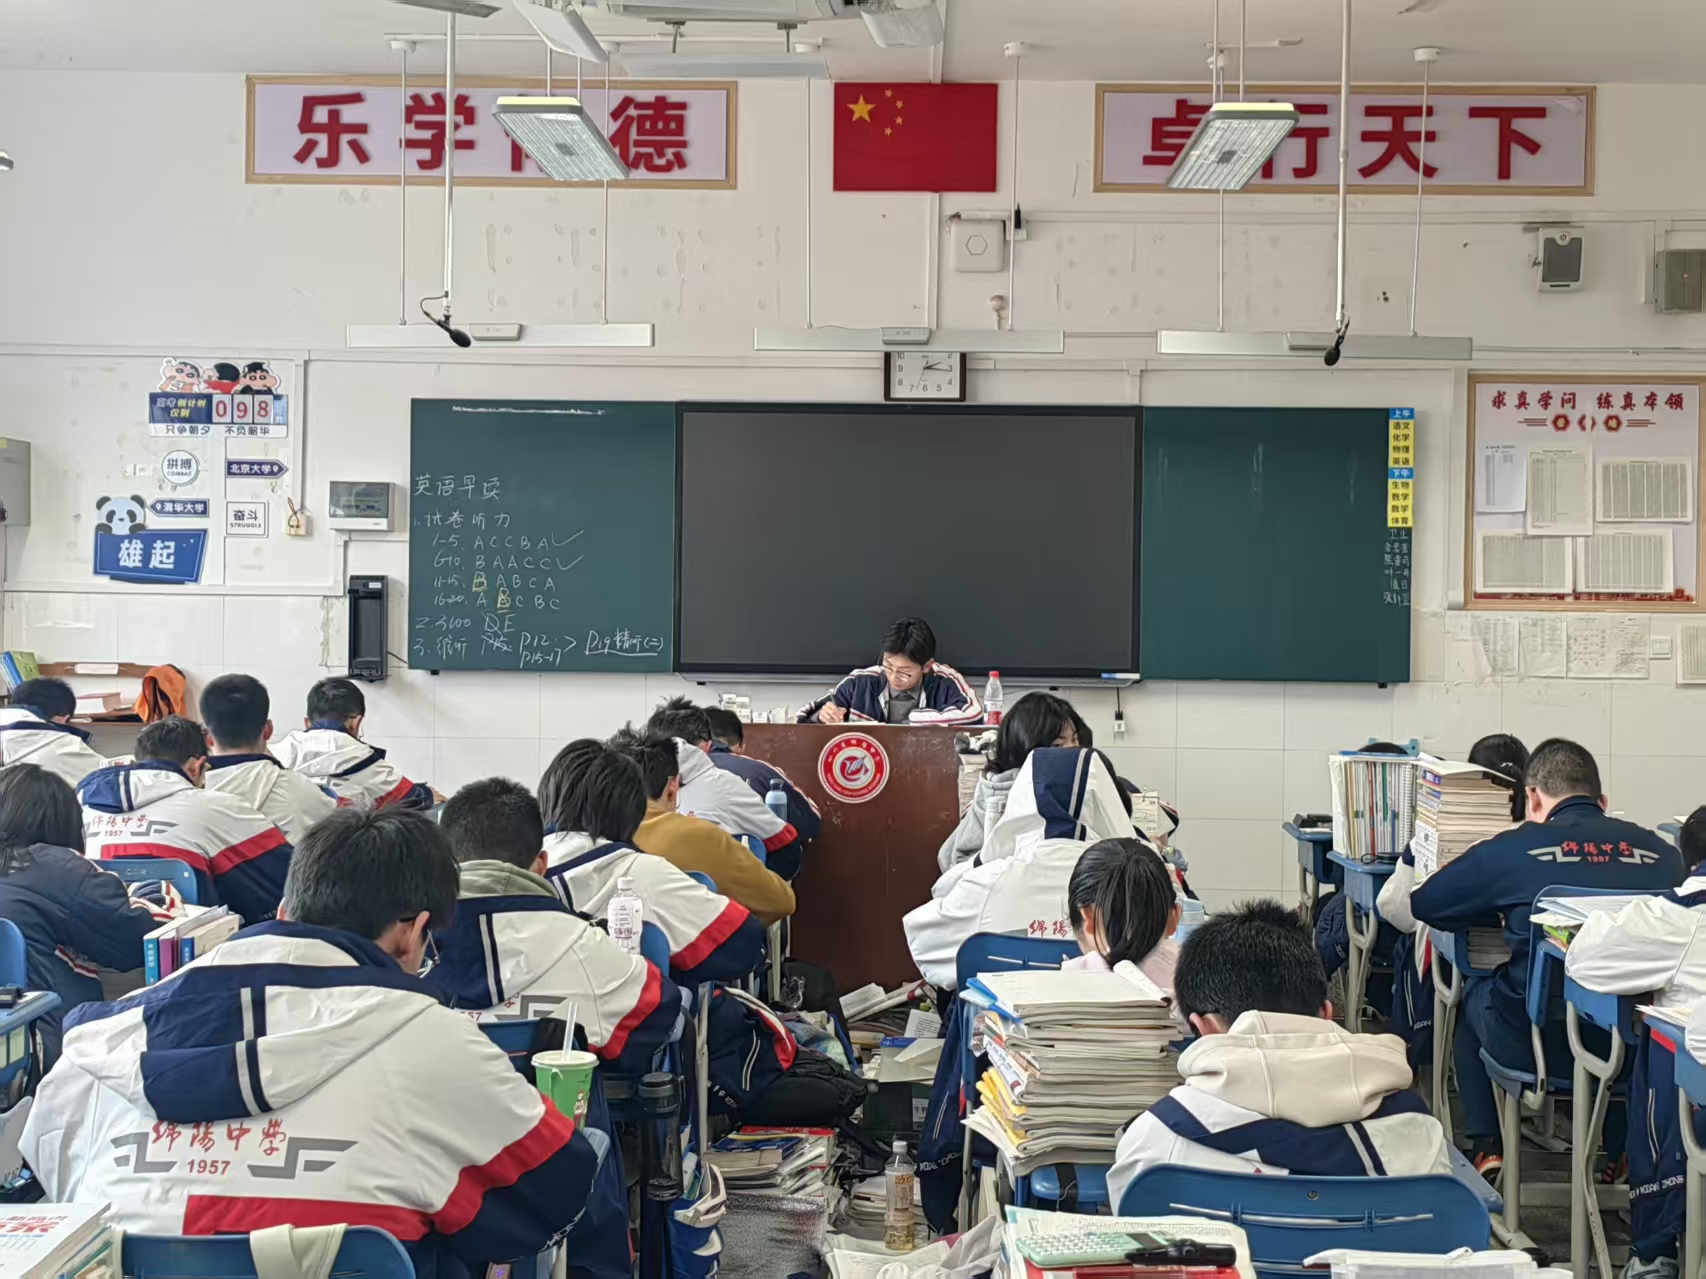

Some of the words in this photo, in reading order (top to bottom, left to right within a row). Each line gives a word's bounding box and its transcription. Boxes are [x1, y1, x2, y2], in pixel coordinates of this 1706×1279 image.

[293, 92, 688, 173] 乐学德
[897, 352, 905, 360] 10
[897, 364, 904, 373] 9
[947, 364, 953, 372] 3
[897, 378, 904, 386] 8
[947, 377, 953, 386] 4
[908, 384, 915, 393] 7
[922, 383, 929, 392] 6
[936, 383, 942, 392] 5
[1491, 390, 1577, 411] 求真学问
[1596, 391, 1684, 411] 练真本领
[215, 400, 269, 419] 098
[1393, 409, 1411, 418] 上午
[165, 425, 210, 435] 只争朝夕
[224, 425, 271, 436] 不负韶华
[1393, 422, 1410, 430] 语文
[1392, 434, 1410, 442] 化学
[1392, 446, 1410, 454] 物理
[167, 457, 192, 470] 拼搏
[1392, 457, 1410, 466] 英语
[230, 463, 271, 474] 北京大学
[1392, 469, 1410, 477] 下午
[413, 474, 501, 500] 英语早读
[1391, 481, 1410, 489] 生物
[1391, 493, 1409, 501] 数学
[1391, 505, 1409, 513] 数学
[233, 509, 259, 522] 奋斗
[425, 508, 510, 529] 试卷听力
[1391, 517, 1408, 525] 体育
[118, 538, 175, 569] 雄起
[1587, 855, 1610, 863] 1957
[187, 1158, 232, 1175] 1957
